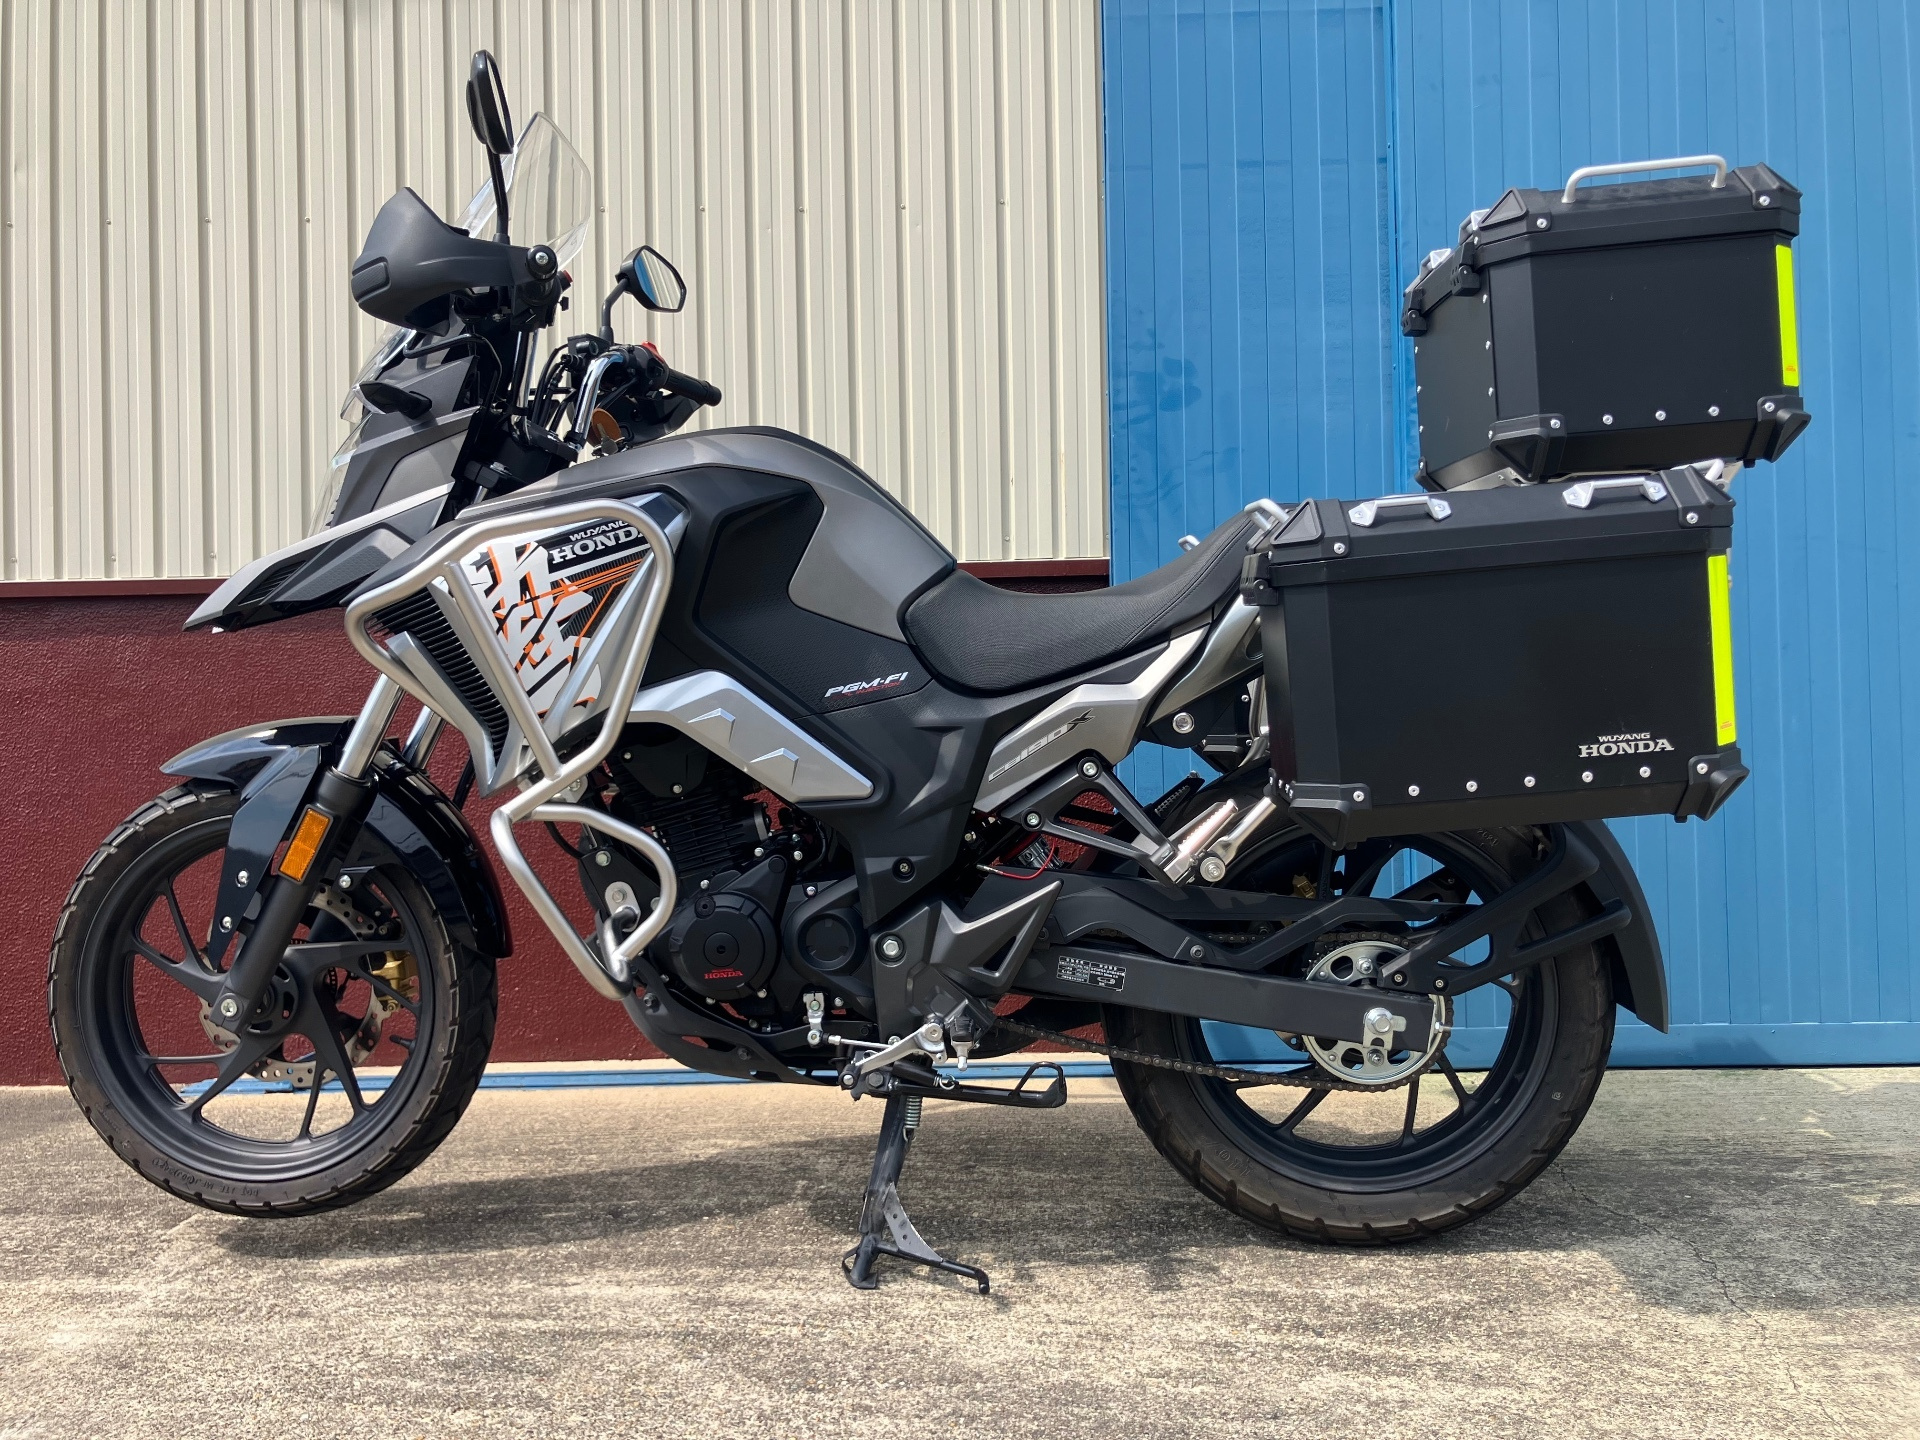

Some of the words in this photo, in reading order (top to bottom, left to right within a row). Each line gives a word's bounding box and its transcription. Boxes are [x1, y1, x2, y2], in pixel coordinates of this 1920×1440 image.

[549, 526, 644, 564] HOND
[824, 671, 909, 698] PGM-FI
[988, 707, 1096, 783] CB190X
[1578, 738, 1675, 758] HONDA
[1597, 732, 1651, 743] WUYANG
[704, 970, 743, 980] HONDA
